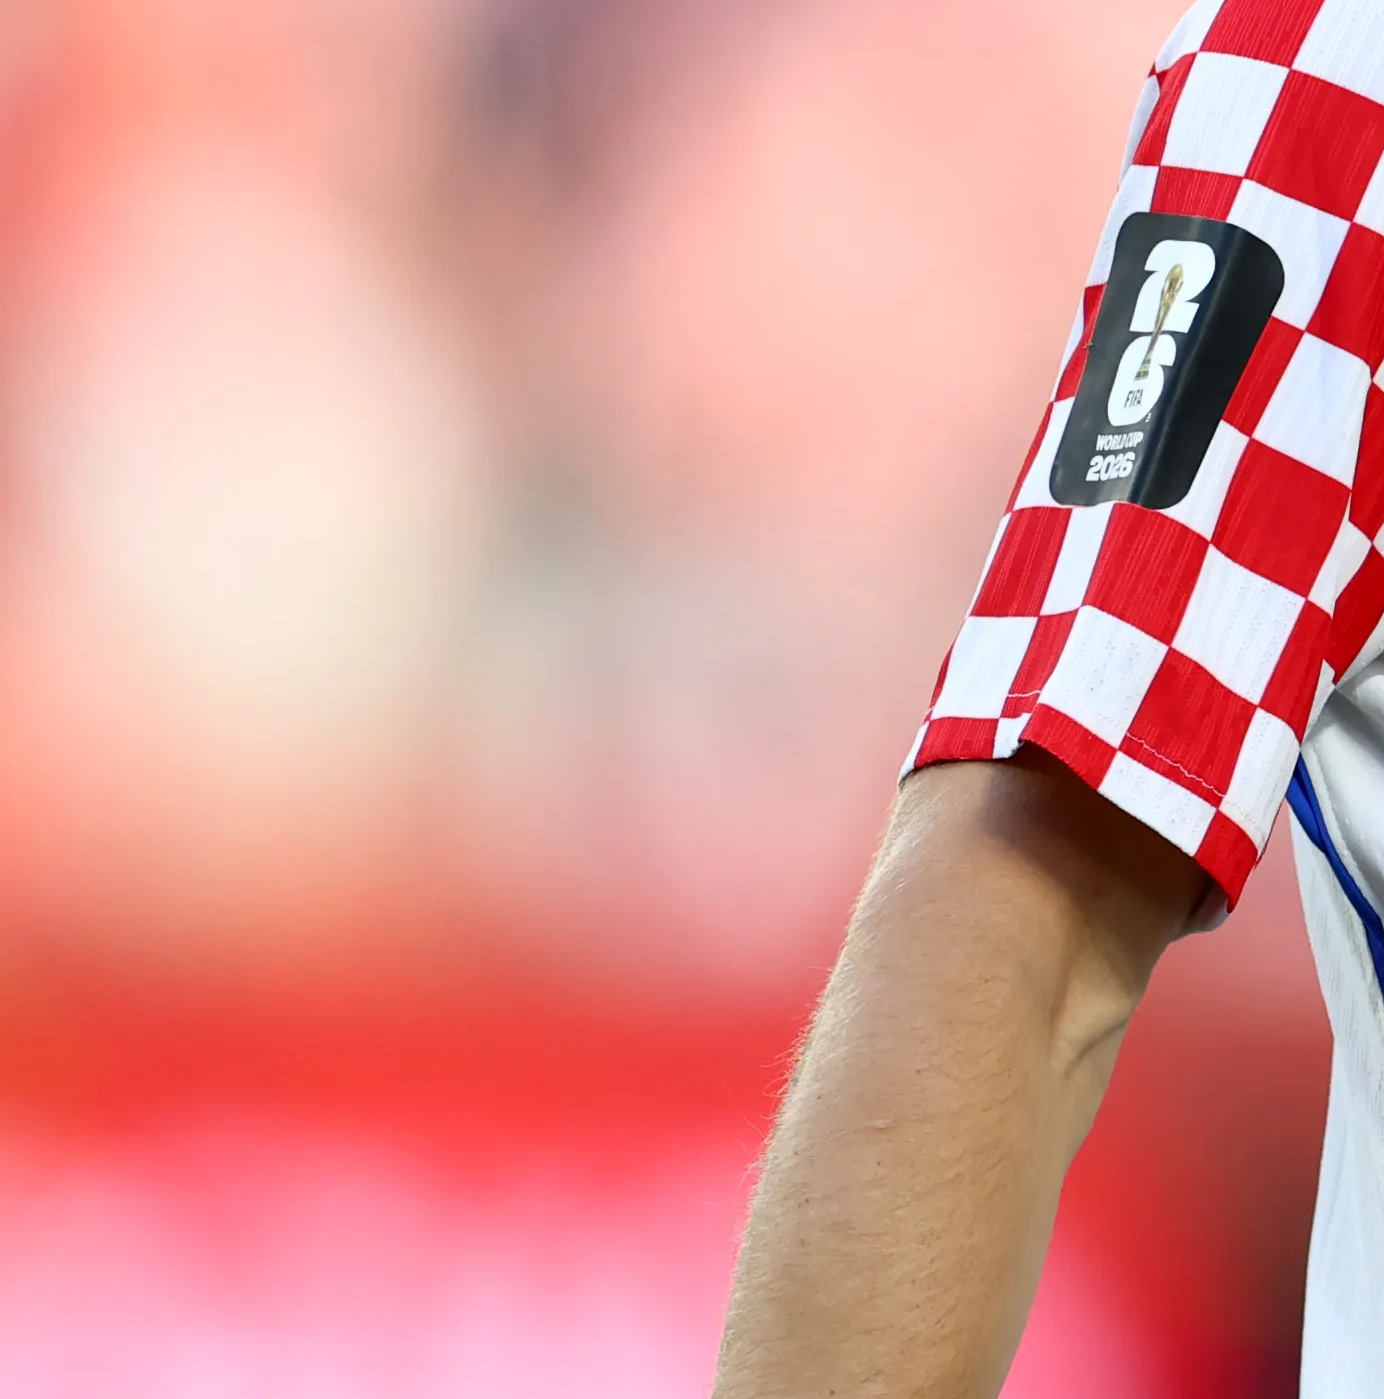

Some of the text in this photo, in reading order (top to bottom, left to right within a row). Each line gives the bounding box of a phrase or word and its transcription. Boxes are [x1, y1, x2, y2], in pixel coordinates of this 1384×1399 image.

[1124, 388, 1144, 409] FIFA
[1096, 431, 1144, 451] WORLD CUP
[1085, 451, 1136, 482] 2026
